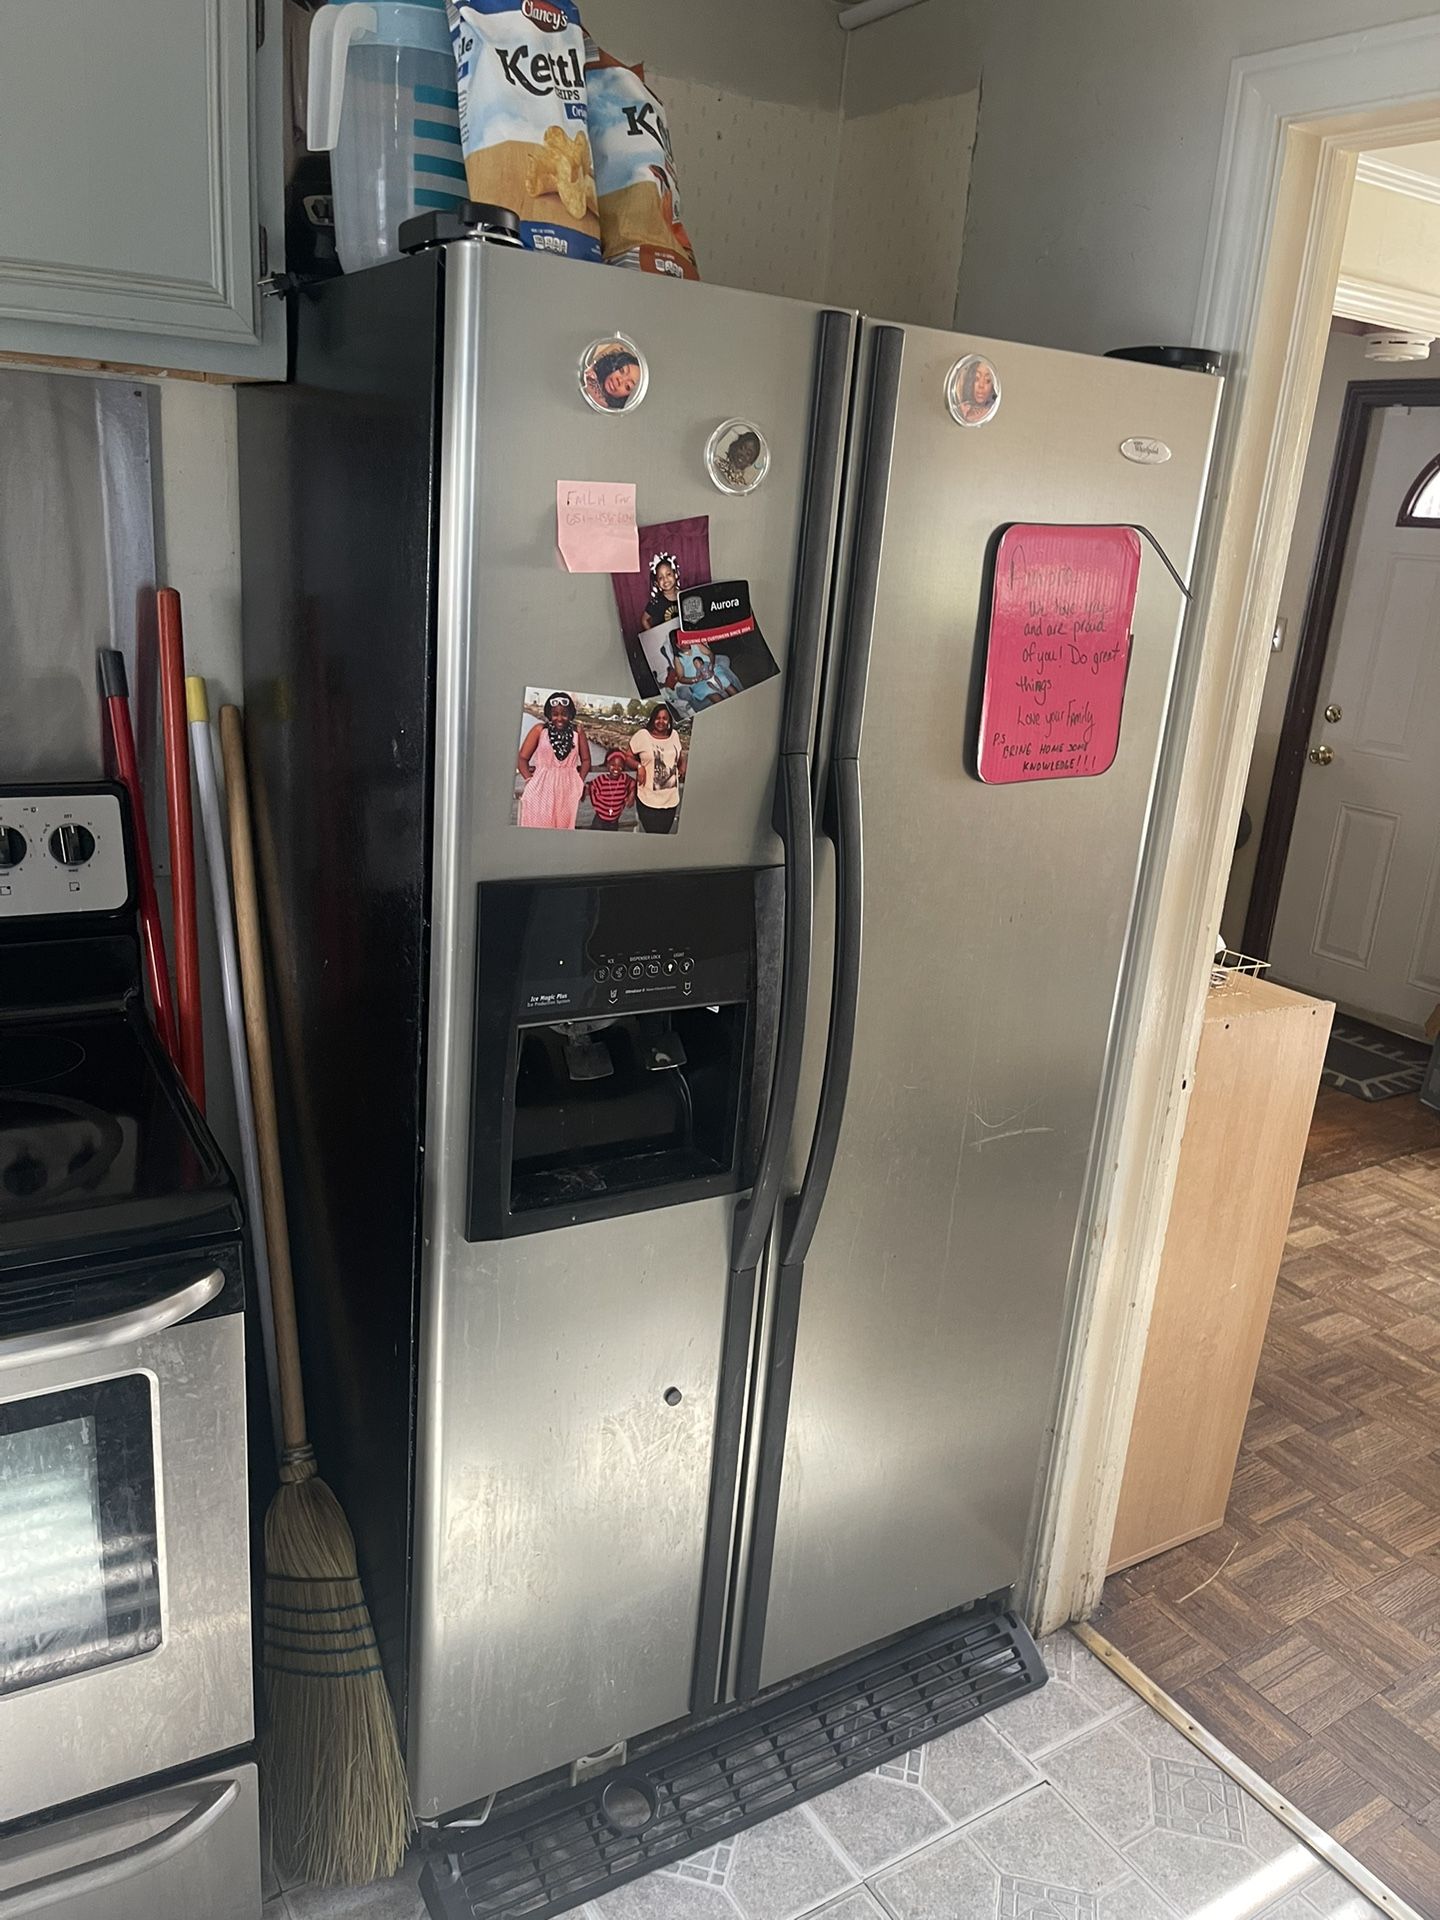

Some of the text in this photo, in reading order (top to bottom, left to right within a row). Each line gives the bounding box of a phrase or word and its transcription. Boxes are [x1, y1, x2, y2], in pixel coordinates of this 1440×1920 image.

[521, 0, 568, 29] Clancy's
[495, 45, 587, 96] Kettl
[555, 87, 580, 101] CHIPS
[710, 598, 740, 612] Aurora
[1024, 617, 1106, 642] and are proud
[1036, 645, 1062, 675] you!
[1068, 643, 1088, 664] Do
[1091, 642, 1120, 675] great
[1016, 675, 1052, 706] things
[1017, 705, 1041, 726] Love
[1045, 710, 1065, 738] your
[1003, 742, 1032, 759] BRING
[1040, 742, 1065, 755] HOME
[629, 954, 650, 962] DISPENSER
